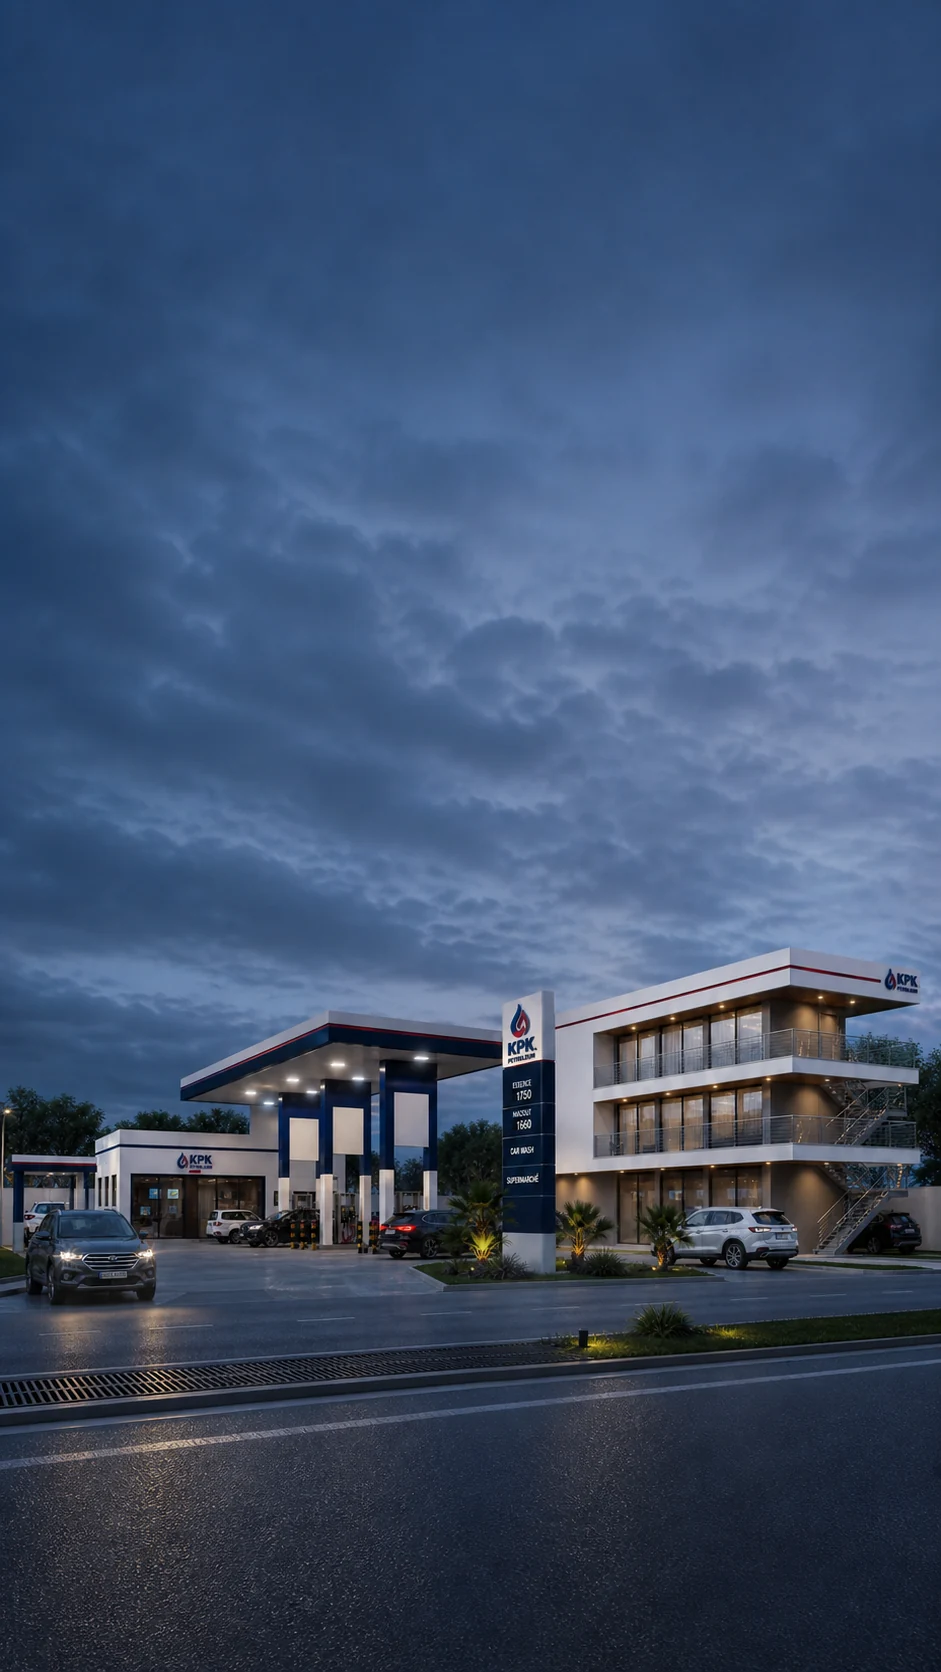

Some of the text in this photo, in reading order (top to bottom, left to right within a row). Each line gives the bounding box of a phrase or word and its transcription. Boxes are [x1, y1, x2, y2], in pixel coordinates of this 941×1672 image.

[897, 973, 918, 988] KPK
[508, 1036, 535, 1056] KPK
[516, 1089, 532, 1101] 1750
[516, 1119, 532, 1130] 1660
[510, 1146, 534, 1155] CAR WASH
[190, 1154, 212, 1165] KPK
